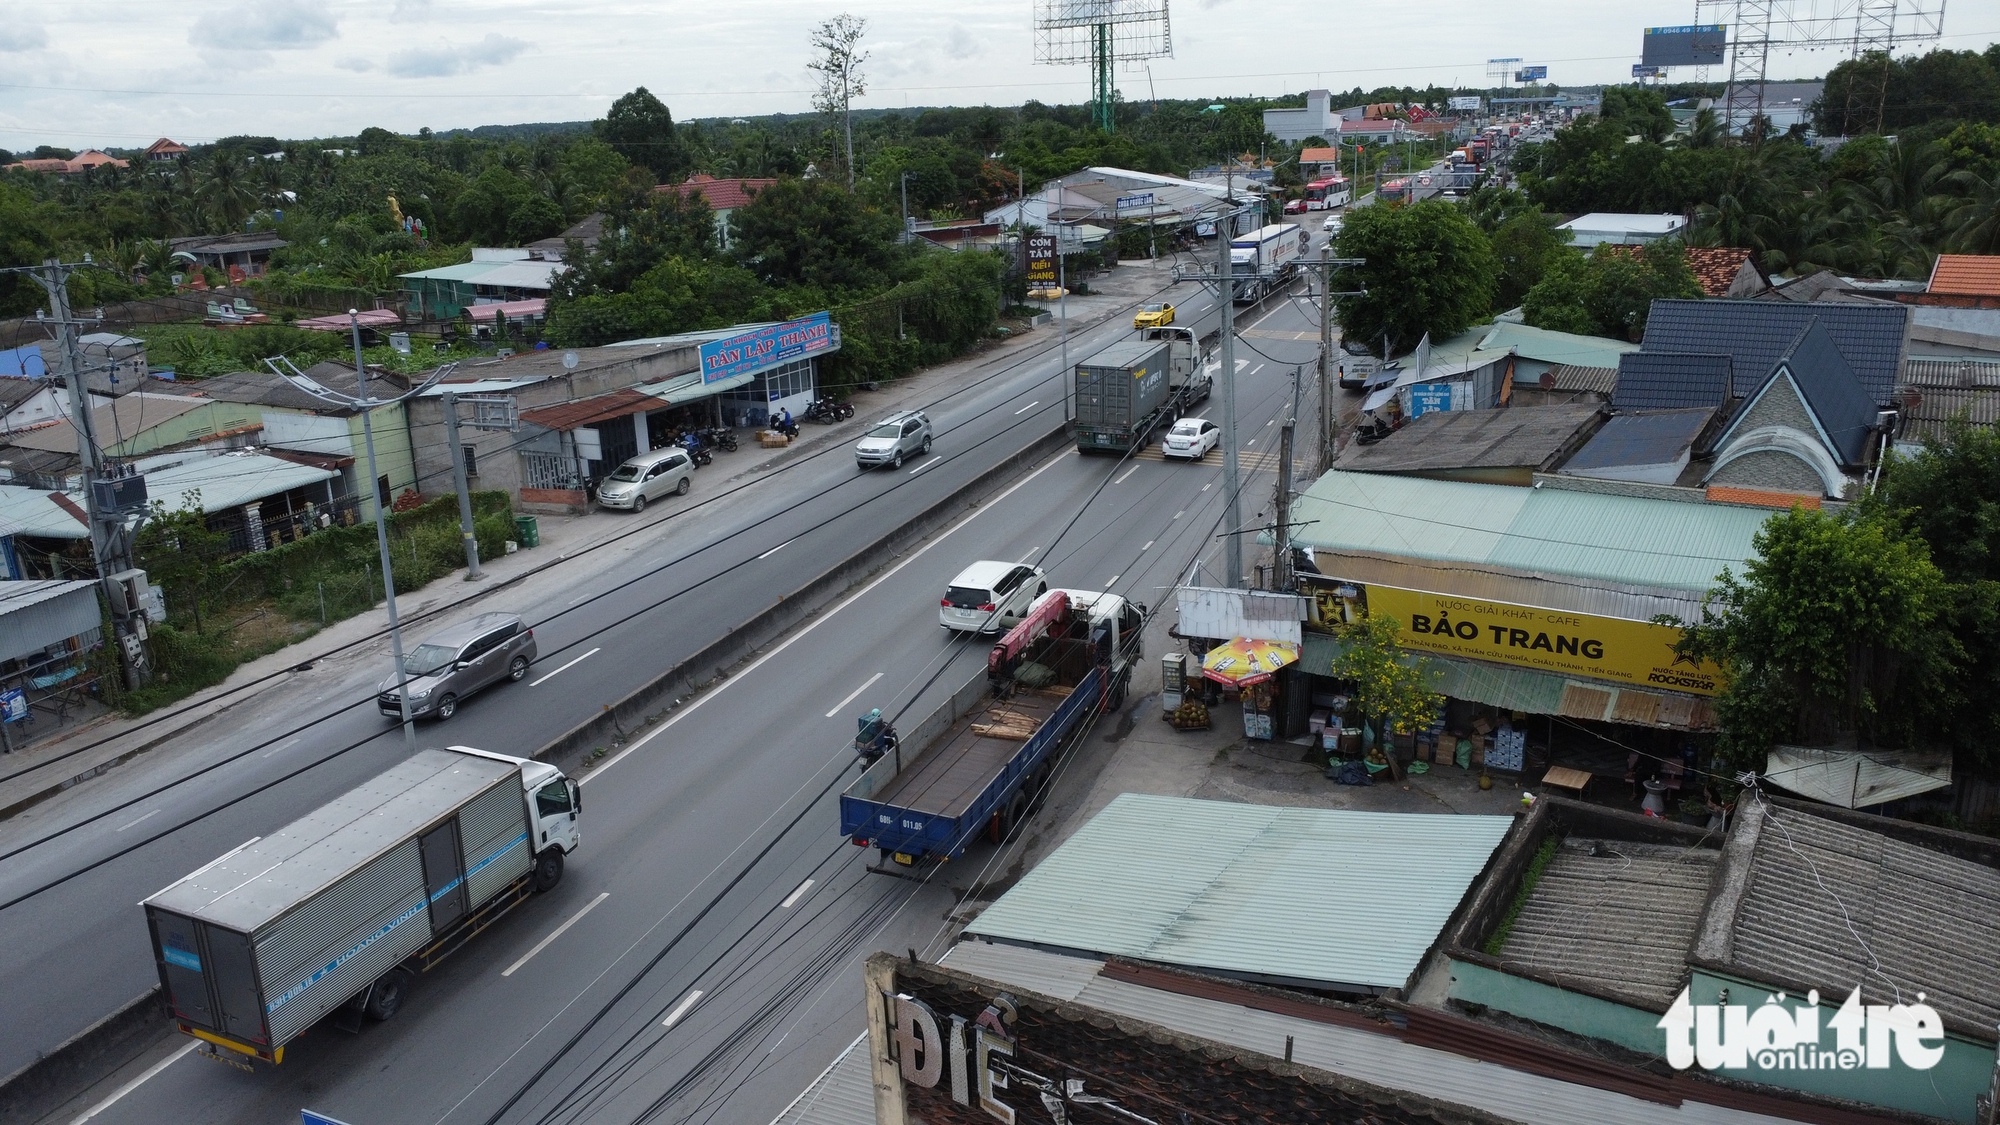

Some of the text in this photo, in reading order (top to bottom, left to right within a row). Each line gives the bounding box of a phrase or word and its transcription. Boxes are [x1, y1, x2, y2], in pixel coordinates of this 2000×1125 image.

[1030, 237, 1052, 246] CƠM
[1030, 247, 1052, 258] TẤM
[1028, 272, 1054, 280] GIANG
[706, 348, 740, 370] TÂN
[745, 339, 776, 359] LẬP
[779, 323, 828, 348] THÀNH
[1436, 599, 1470, 612] NƯỚC
[1474, 604, 1498, 615] GIẢI
[1502, 609, 1534, 620] KHÁT
[1547, 615, 1580, 627] CAFE
[1412, 610, 1604, 660] BẢO TRANG
[1607, 670, 1633, 679] GIANG
[1652, 666, 1674, 675] NƯỚC
[1675, 670, 1696, 678] TĂNG
[1648, 672, 1716, 690] ROCKSTAR
[902, 820, 922, 830] 011.05
[387, 906, 418, 930] VINH
